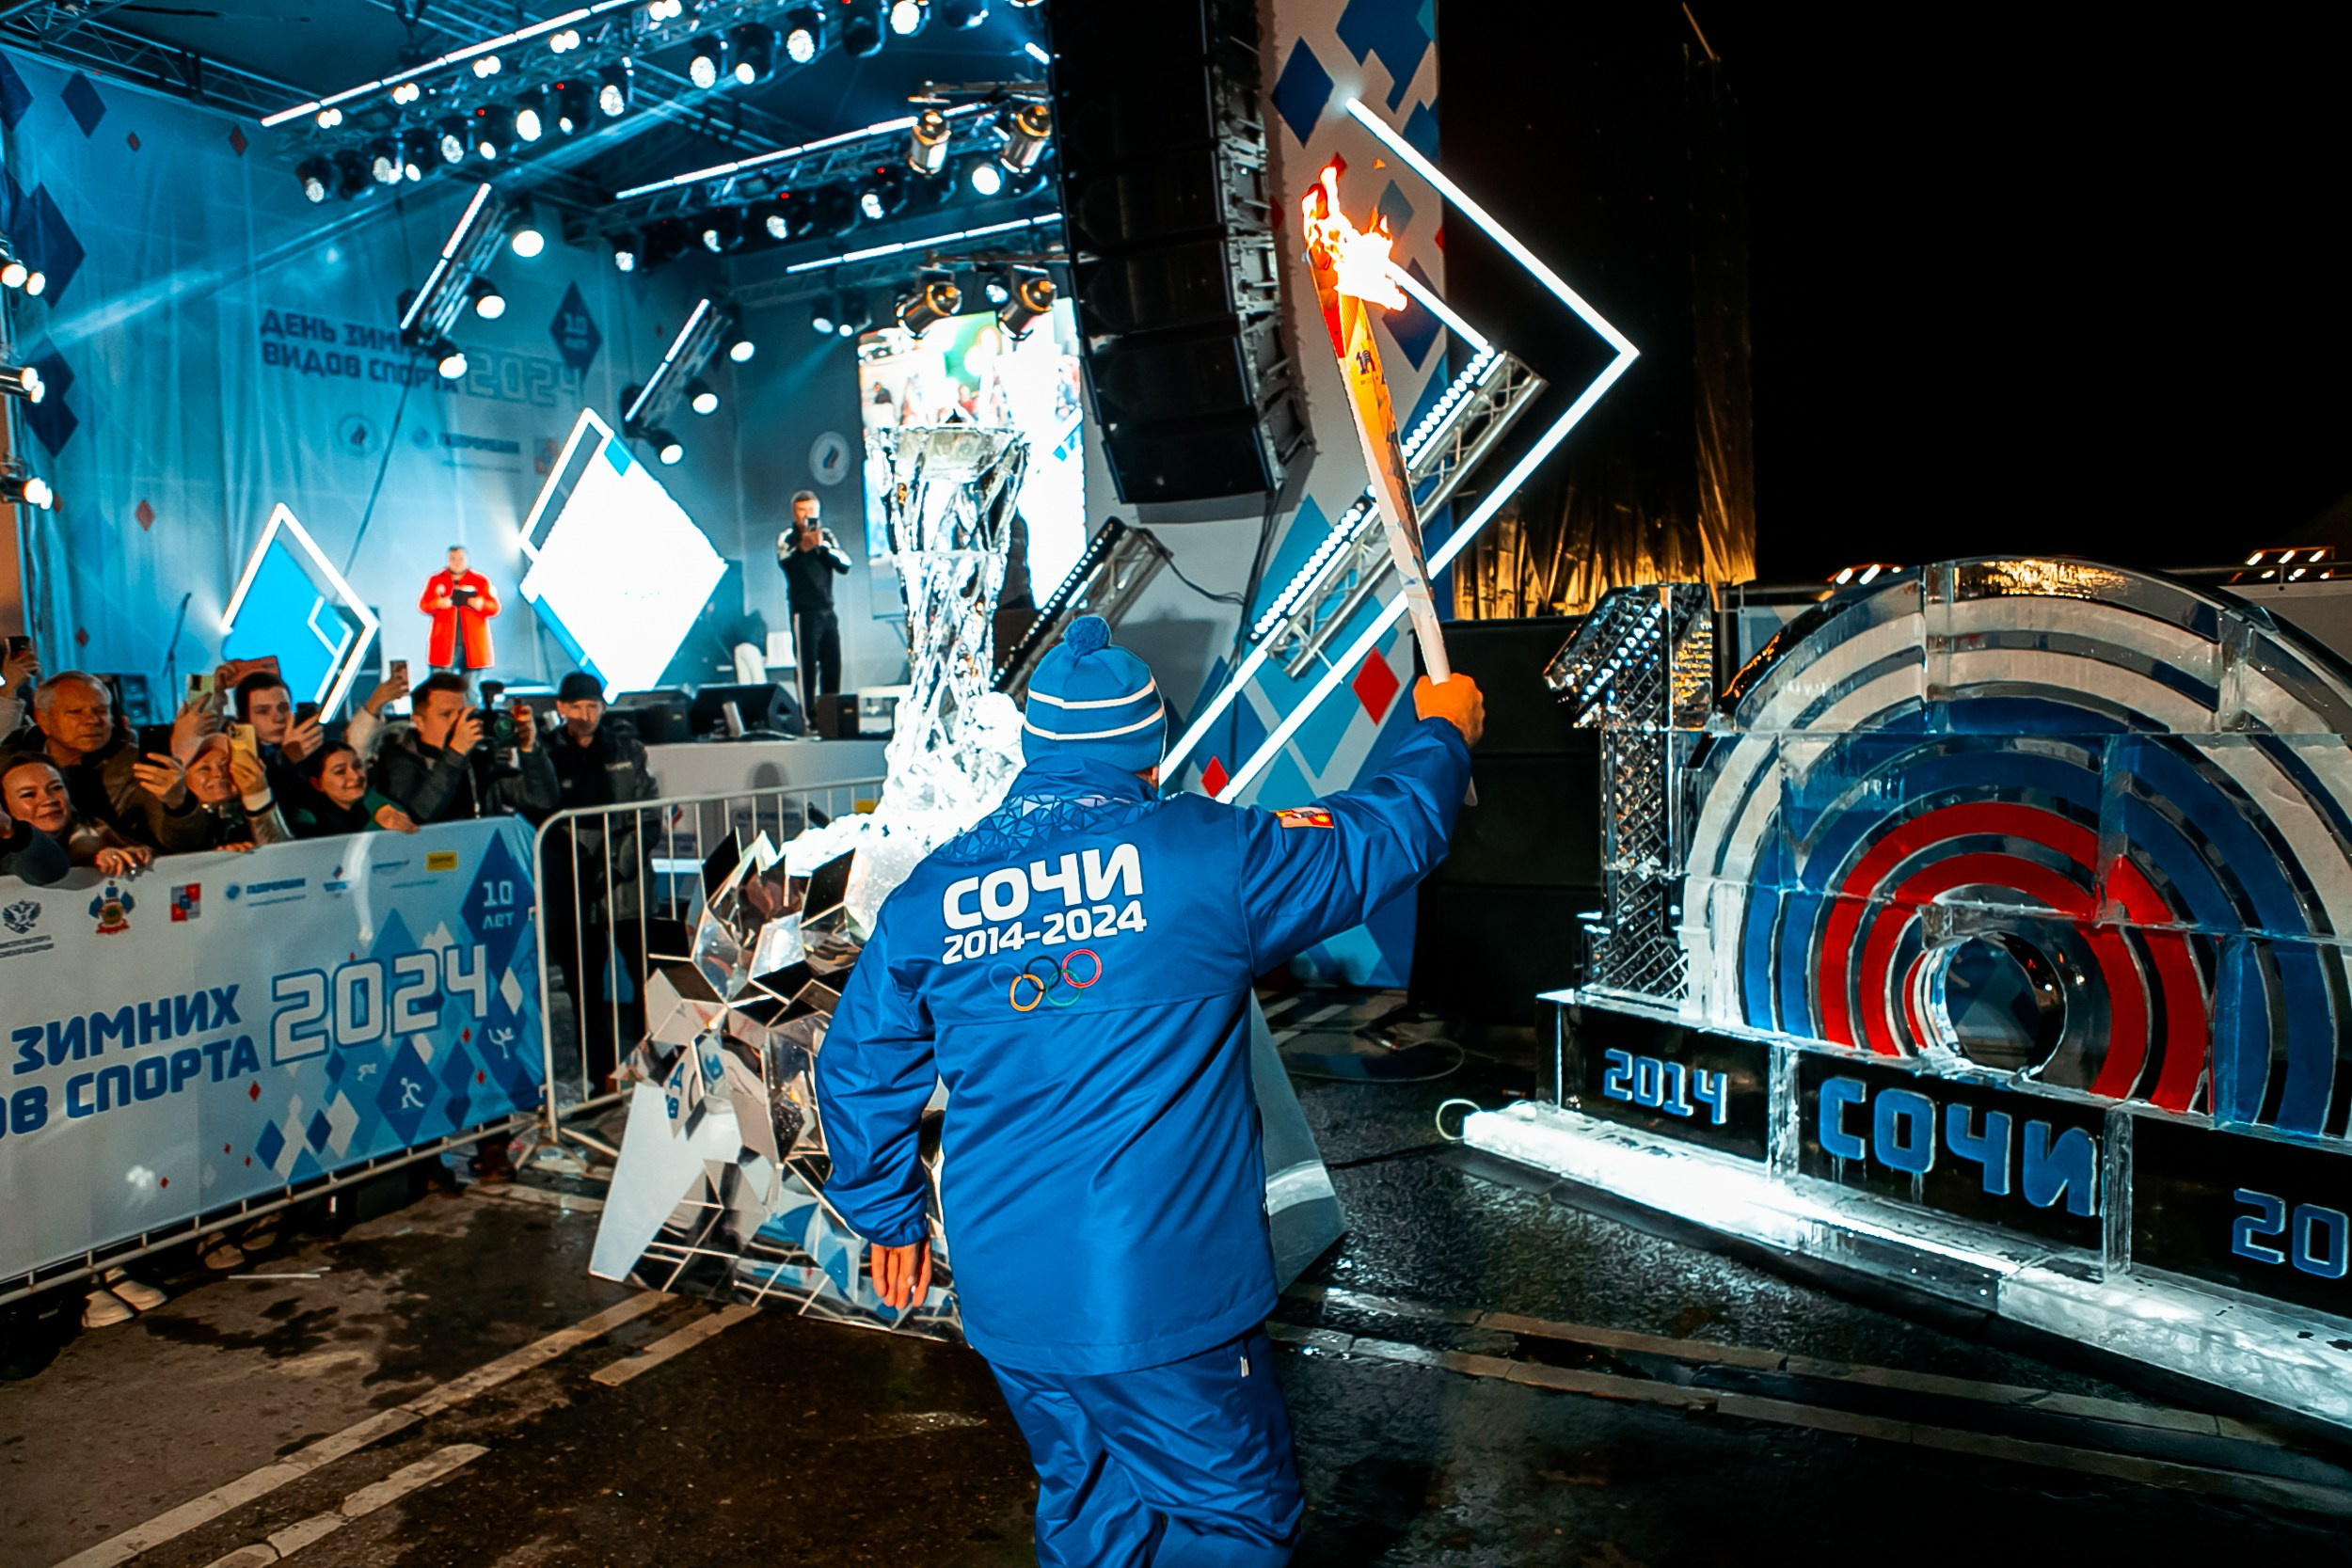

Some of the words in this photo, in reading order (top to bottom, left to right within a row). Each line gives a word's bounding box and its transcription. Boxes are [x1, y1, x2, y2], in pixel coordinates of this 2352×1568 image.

[261, 309, 337, 343] ДЕНЬ
[262, 341, 361, 378] ВИДОВ
[465, 346, 585, 412] 2024
[482, 880, 514, 908] 10
[943, 844, 1143, 929] СОЧИ
[482, 911, 515, 930] ЛЕТ
[942, 900, 1148, 965] 2014-2024
[12, 984, 241, 1075] ЗИМНИХ
[270, 944, 488, 1067] 2024
[65, 1035, 261, 1119] СПОРТА
[1603, 1048, 1727, 1125] 2014
[1819, 1075, 2098, 1218] СОЧИ
[2233, 1188, 2349, 1279] 20
